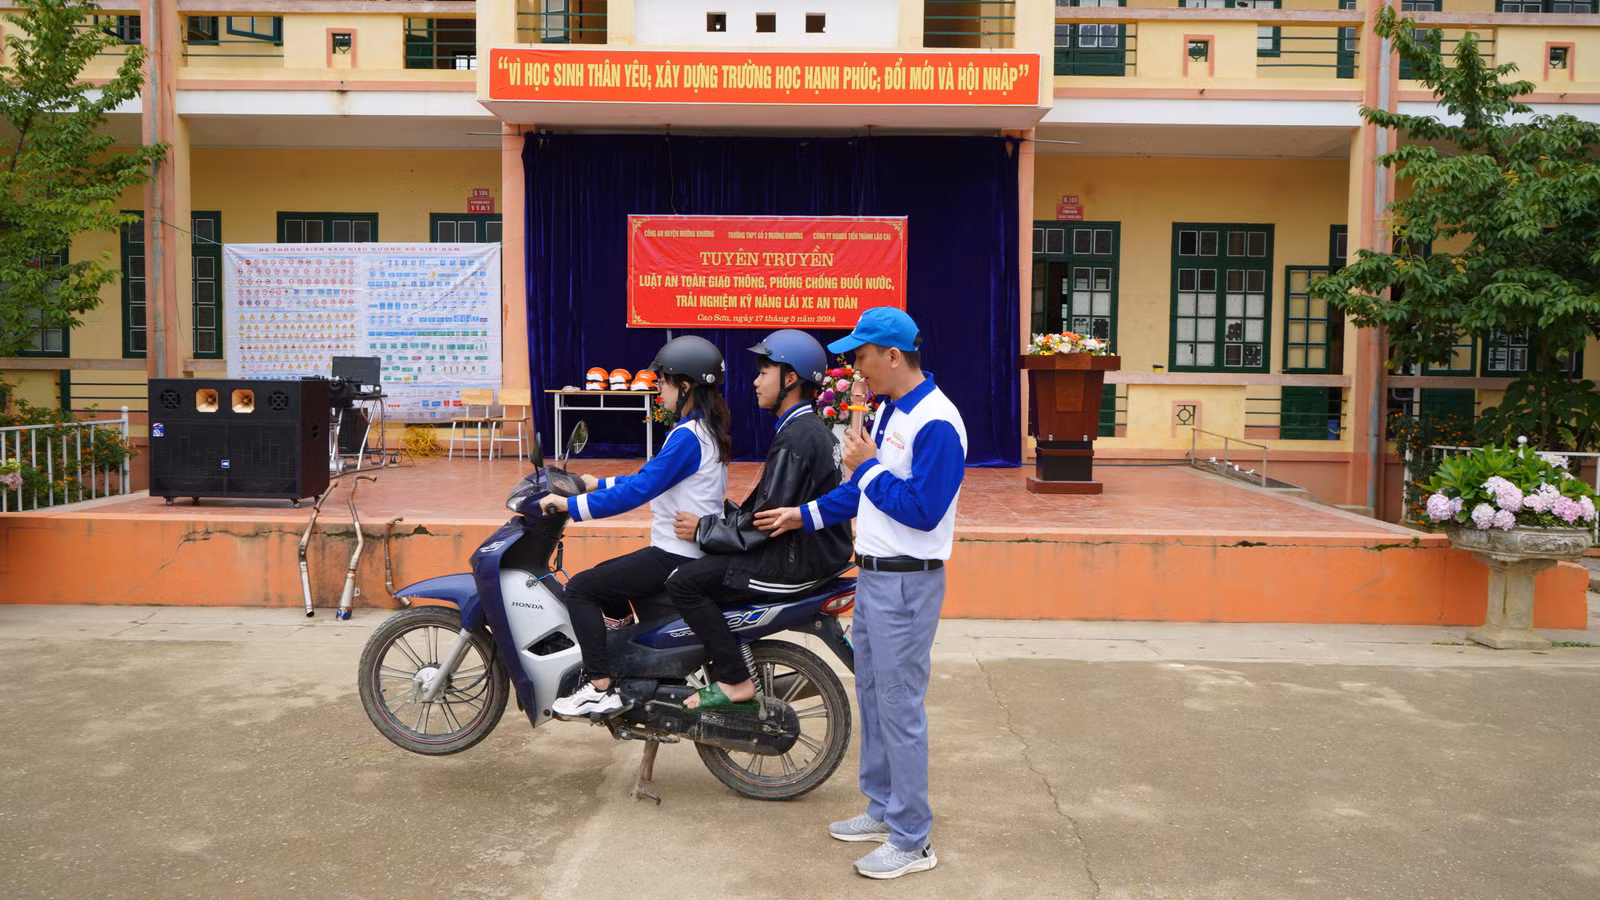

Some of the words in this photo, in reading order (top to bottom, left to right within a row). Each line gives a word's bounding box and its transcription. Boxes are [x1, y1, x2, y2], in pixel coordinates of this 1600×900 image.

[524, 62, 550, 91] HỌC
[554, 63, 584, 86] SINH
[588, 59, 620, 87] THÂN
[624, 59, 652, 90] YÊU;
[655, 60, 680, 88] XÂY
[684, 62, 718, 94] DỰNG
[722, 59, 772, 89] TRƯỜNG
[776, 66, 800, 94] HỌC
[804, 66, 840, 94] HẠNH
[843, 62, 881, 92] PHÚC;
[884, 58, 906, 90] ĐỔI
[910, 60, 934, 90] MỚI
[938, 62, 954, 90] VÀ
[958, 62, 979, 96] HỘI
[700, 248, 759, 266] TUYÊN
[762, 246, 834, 266] TRUYỀN
[640, 272, 662, 289] LUẬT
[665, 276, 678, 287] AN
[681, 273, 706, 288] TOÀN
[708, 276, 730, 288] GIAO
[733, 274, 767, 290] THÔNG,
[770, 274, 802, 288] PHÒNG
[806, 273, 838, 289] CHỐNG
[840, 273, 863, 289] ĐUỐI
[866, 275, 894, 291] NƯỚC,
[676, 292, 696, 307] TRẢI
[700, 294, 737, 310] NGHIỆM
[740, 294, 752, 308] KỸ
[755, 294, 781, 308] NĂNG
[784, 294, 799, 308] LÁI
[802, 297, 814, 308] XE
[816, 297, 830, 308] AN
[833, 294, 858, 309] TOÀN
[733, 315, 754, 323] ngày
[765, 315, 789, 323] tháng
[512, 601, 544, 610] HONDA
